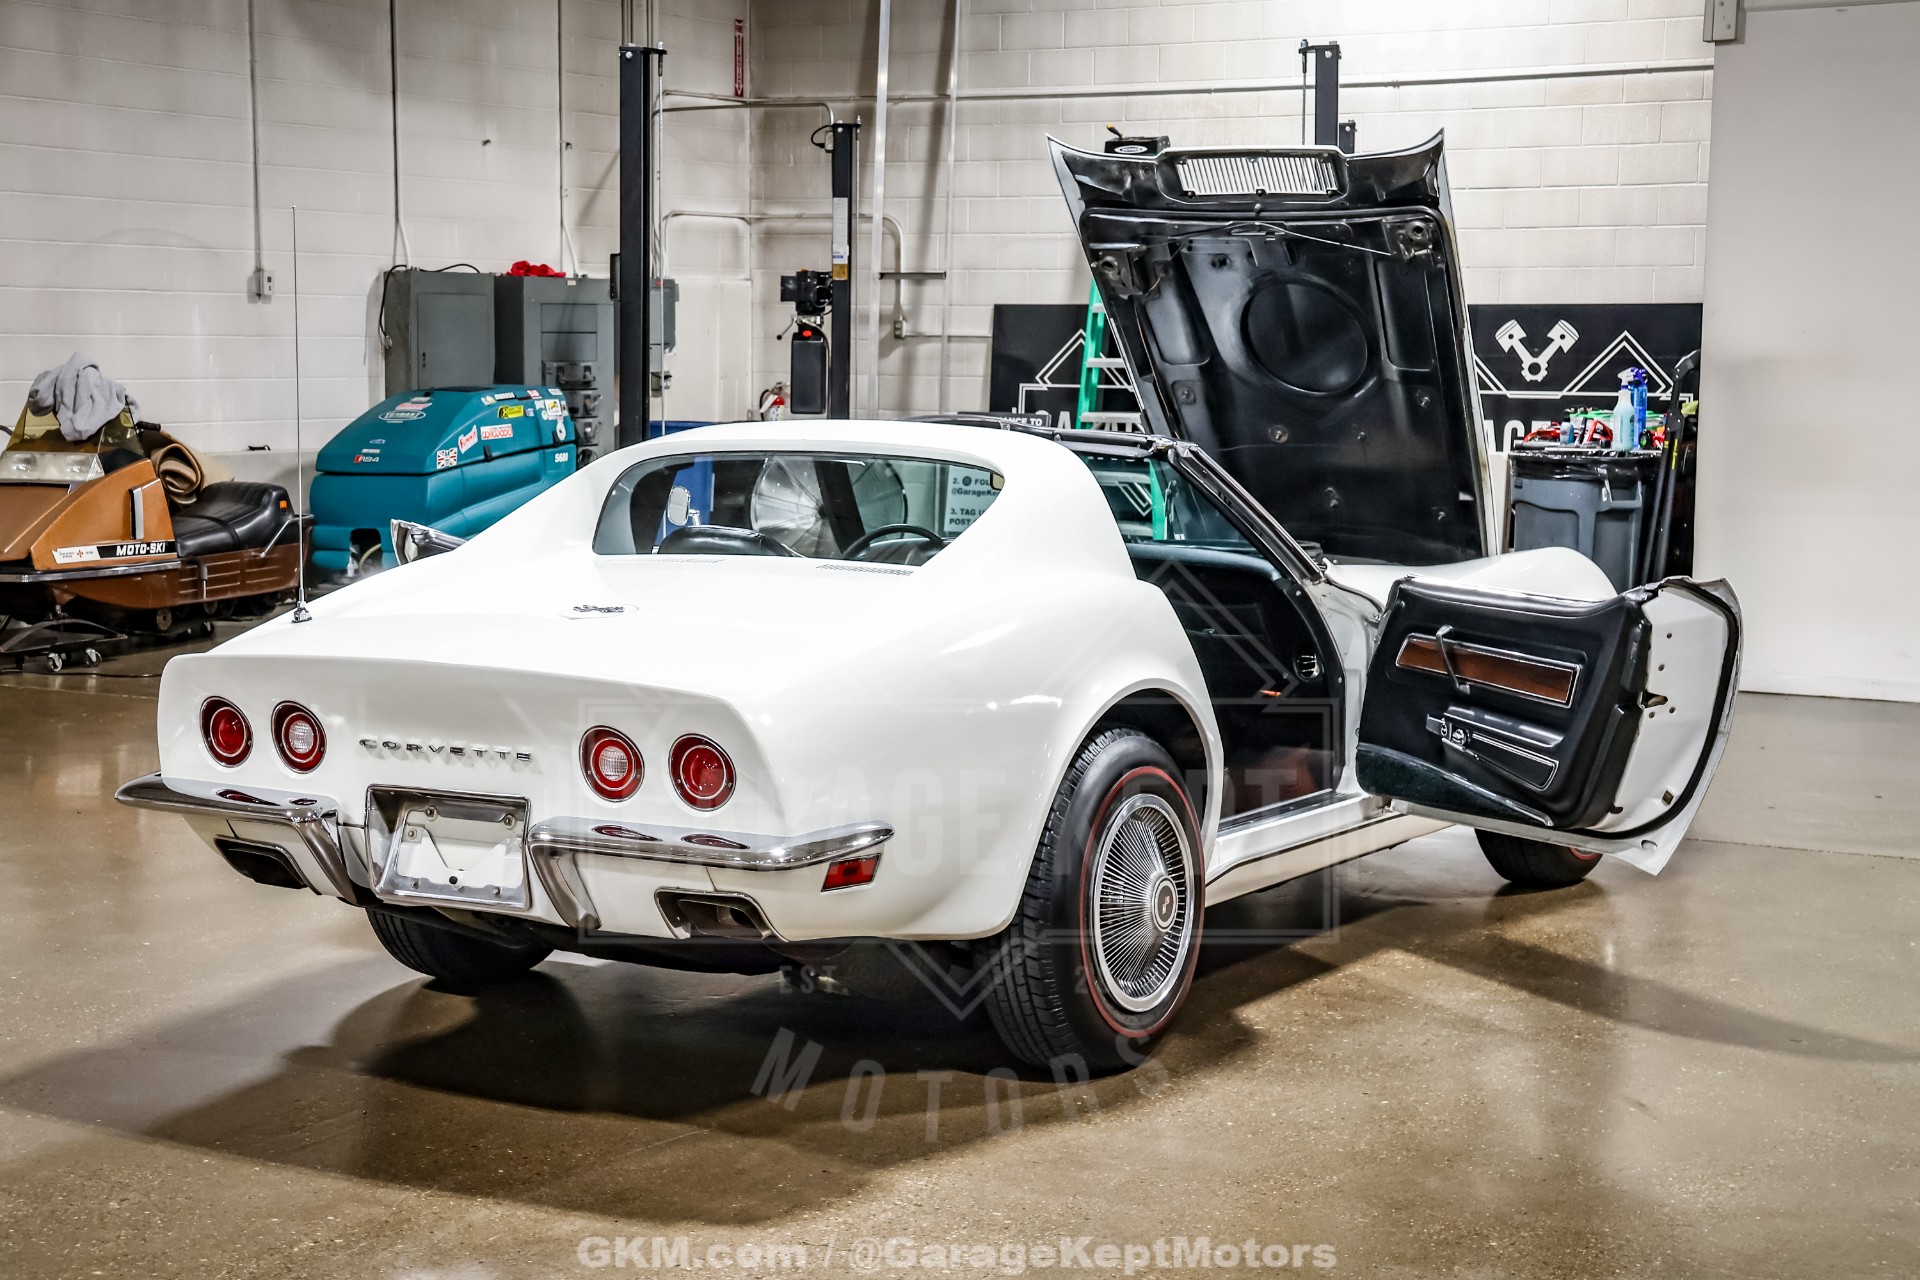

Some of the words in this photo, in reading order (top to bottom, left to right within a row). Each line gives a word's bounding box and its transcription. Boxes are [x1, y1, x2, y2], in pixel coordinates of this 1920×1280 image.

[1030, 418, 1043, 427] TO
[951, 488, 1000, 497] @GarageKe
[949, 518, 971, 526] POST
[358, 737, 534, 763] CORVETTE
